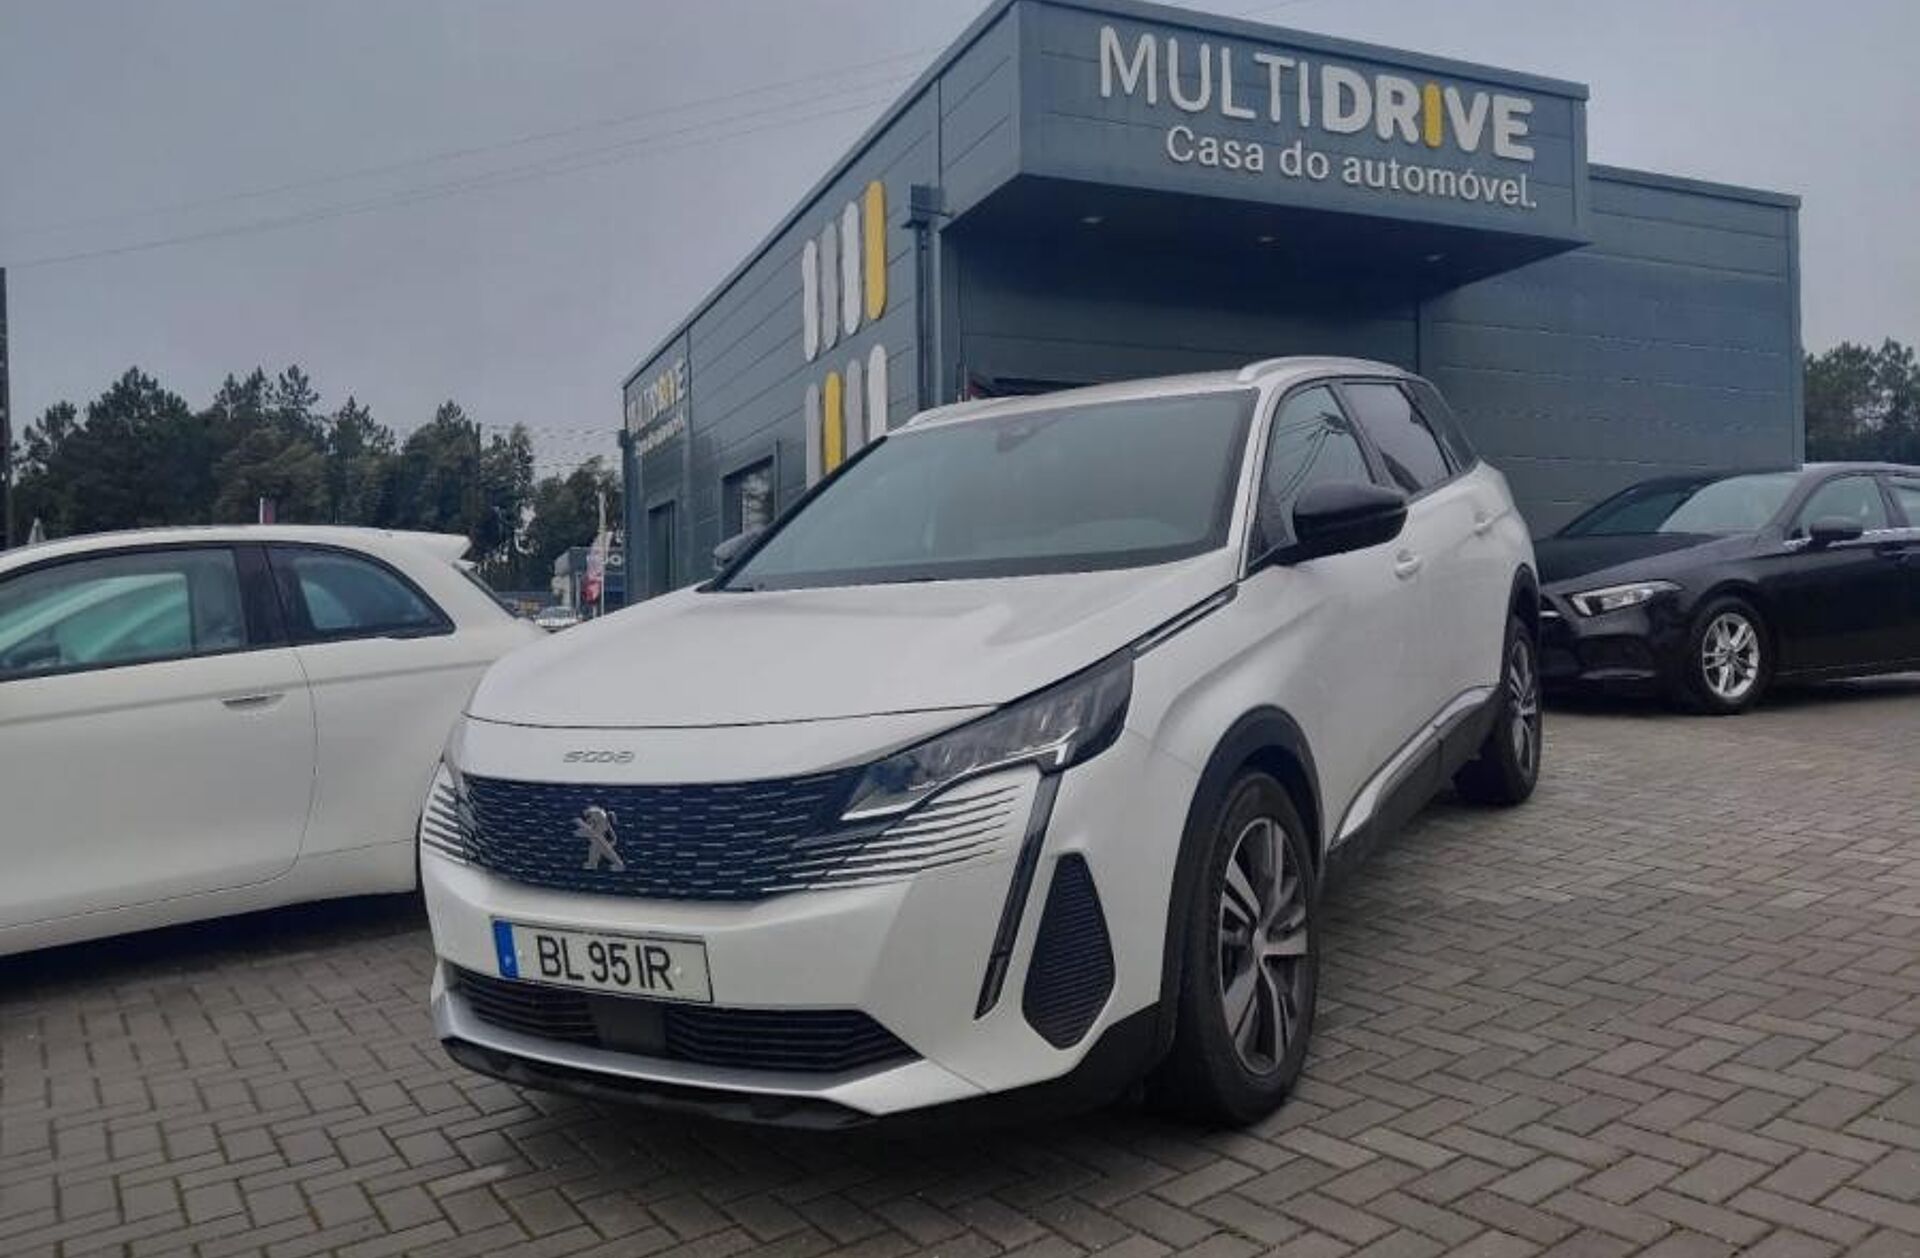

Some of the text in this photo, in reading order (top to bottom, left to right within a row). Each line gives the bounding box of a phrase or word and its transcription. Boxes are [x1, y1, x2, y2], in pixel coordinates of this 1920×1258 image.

[1099, 24, 1536, 162] MULTIDRIVE
[1166, 126, 1538, 210] Casa do automóvel.
